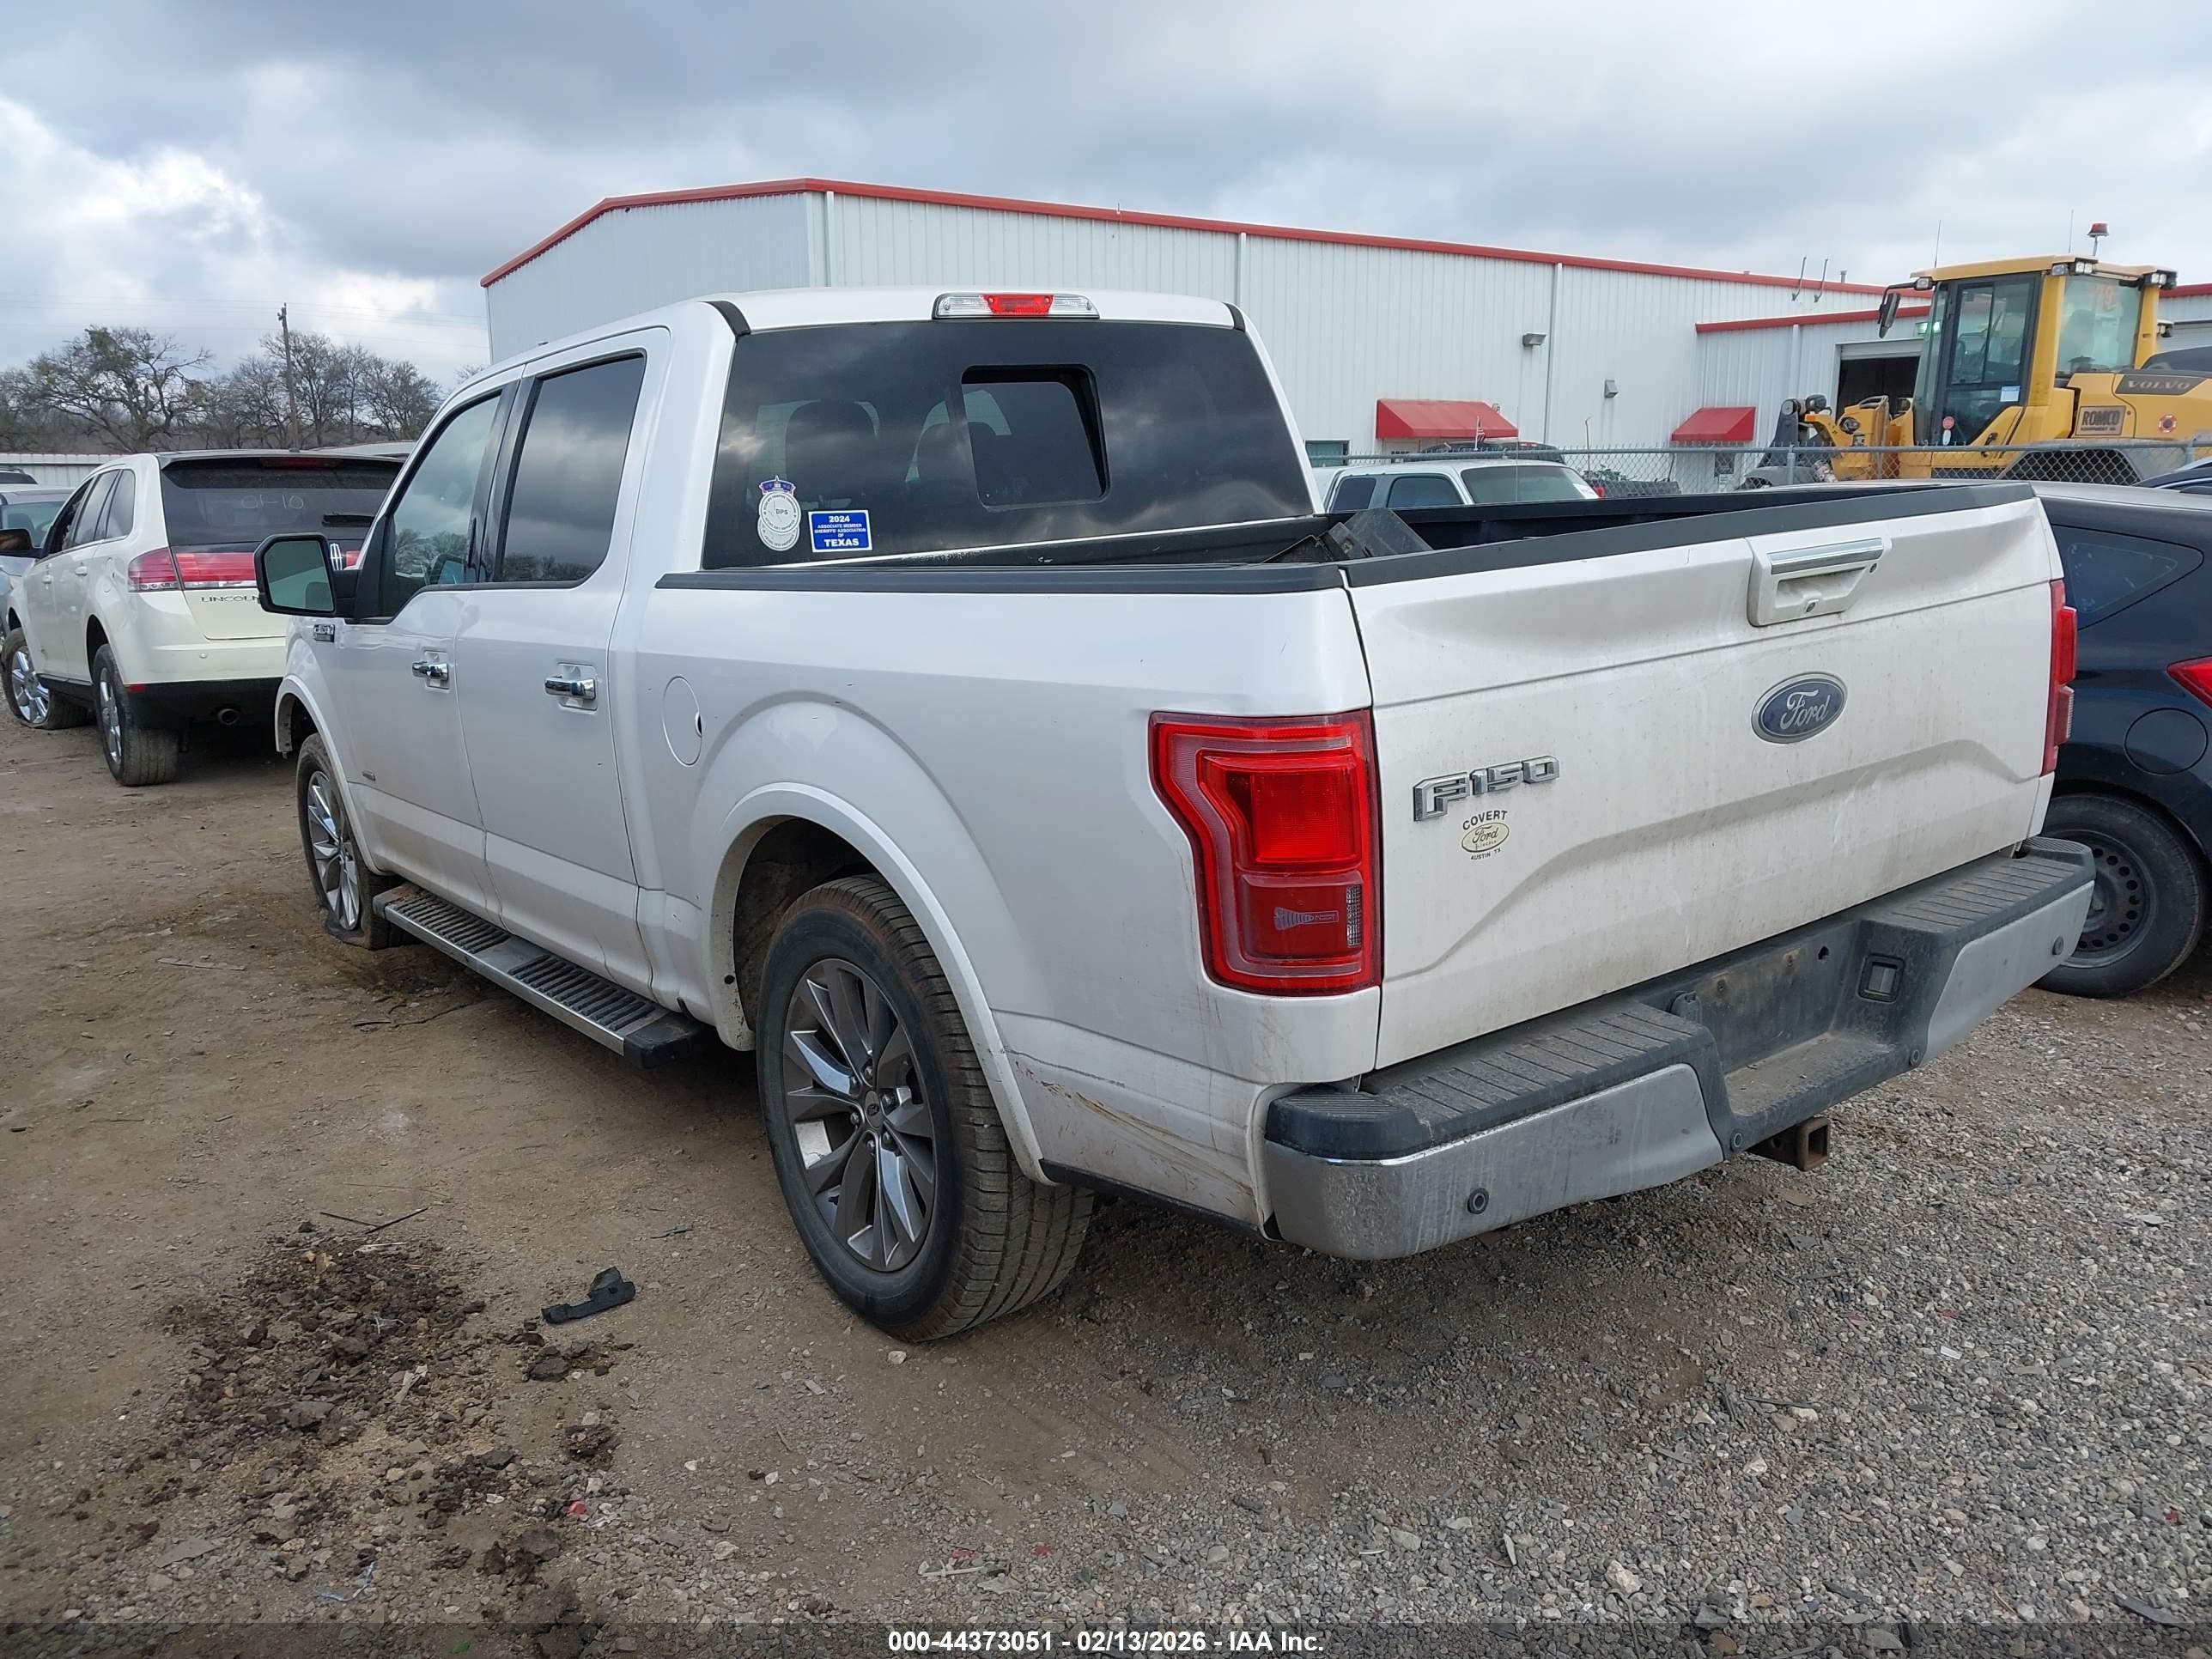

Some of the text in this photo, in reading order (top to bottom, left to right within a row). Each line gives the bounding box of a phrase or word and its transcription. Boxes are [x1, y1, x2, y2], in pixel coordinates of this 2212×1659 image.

[2128, 380, 2191, 390] VOLVO
[2081, 410, 2121, 426] ROMCO
[823, 538, 860, 547] TEXAS
[1780, 689, 1831, 730] Ford
[1413, 755, 1559, 822] F150
[1462, 810, 1508, 830] COVERT
[1472, 824, 1499, 843] Ford
[1470, 852, 1491, 860] AUSTIN
